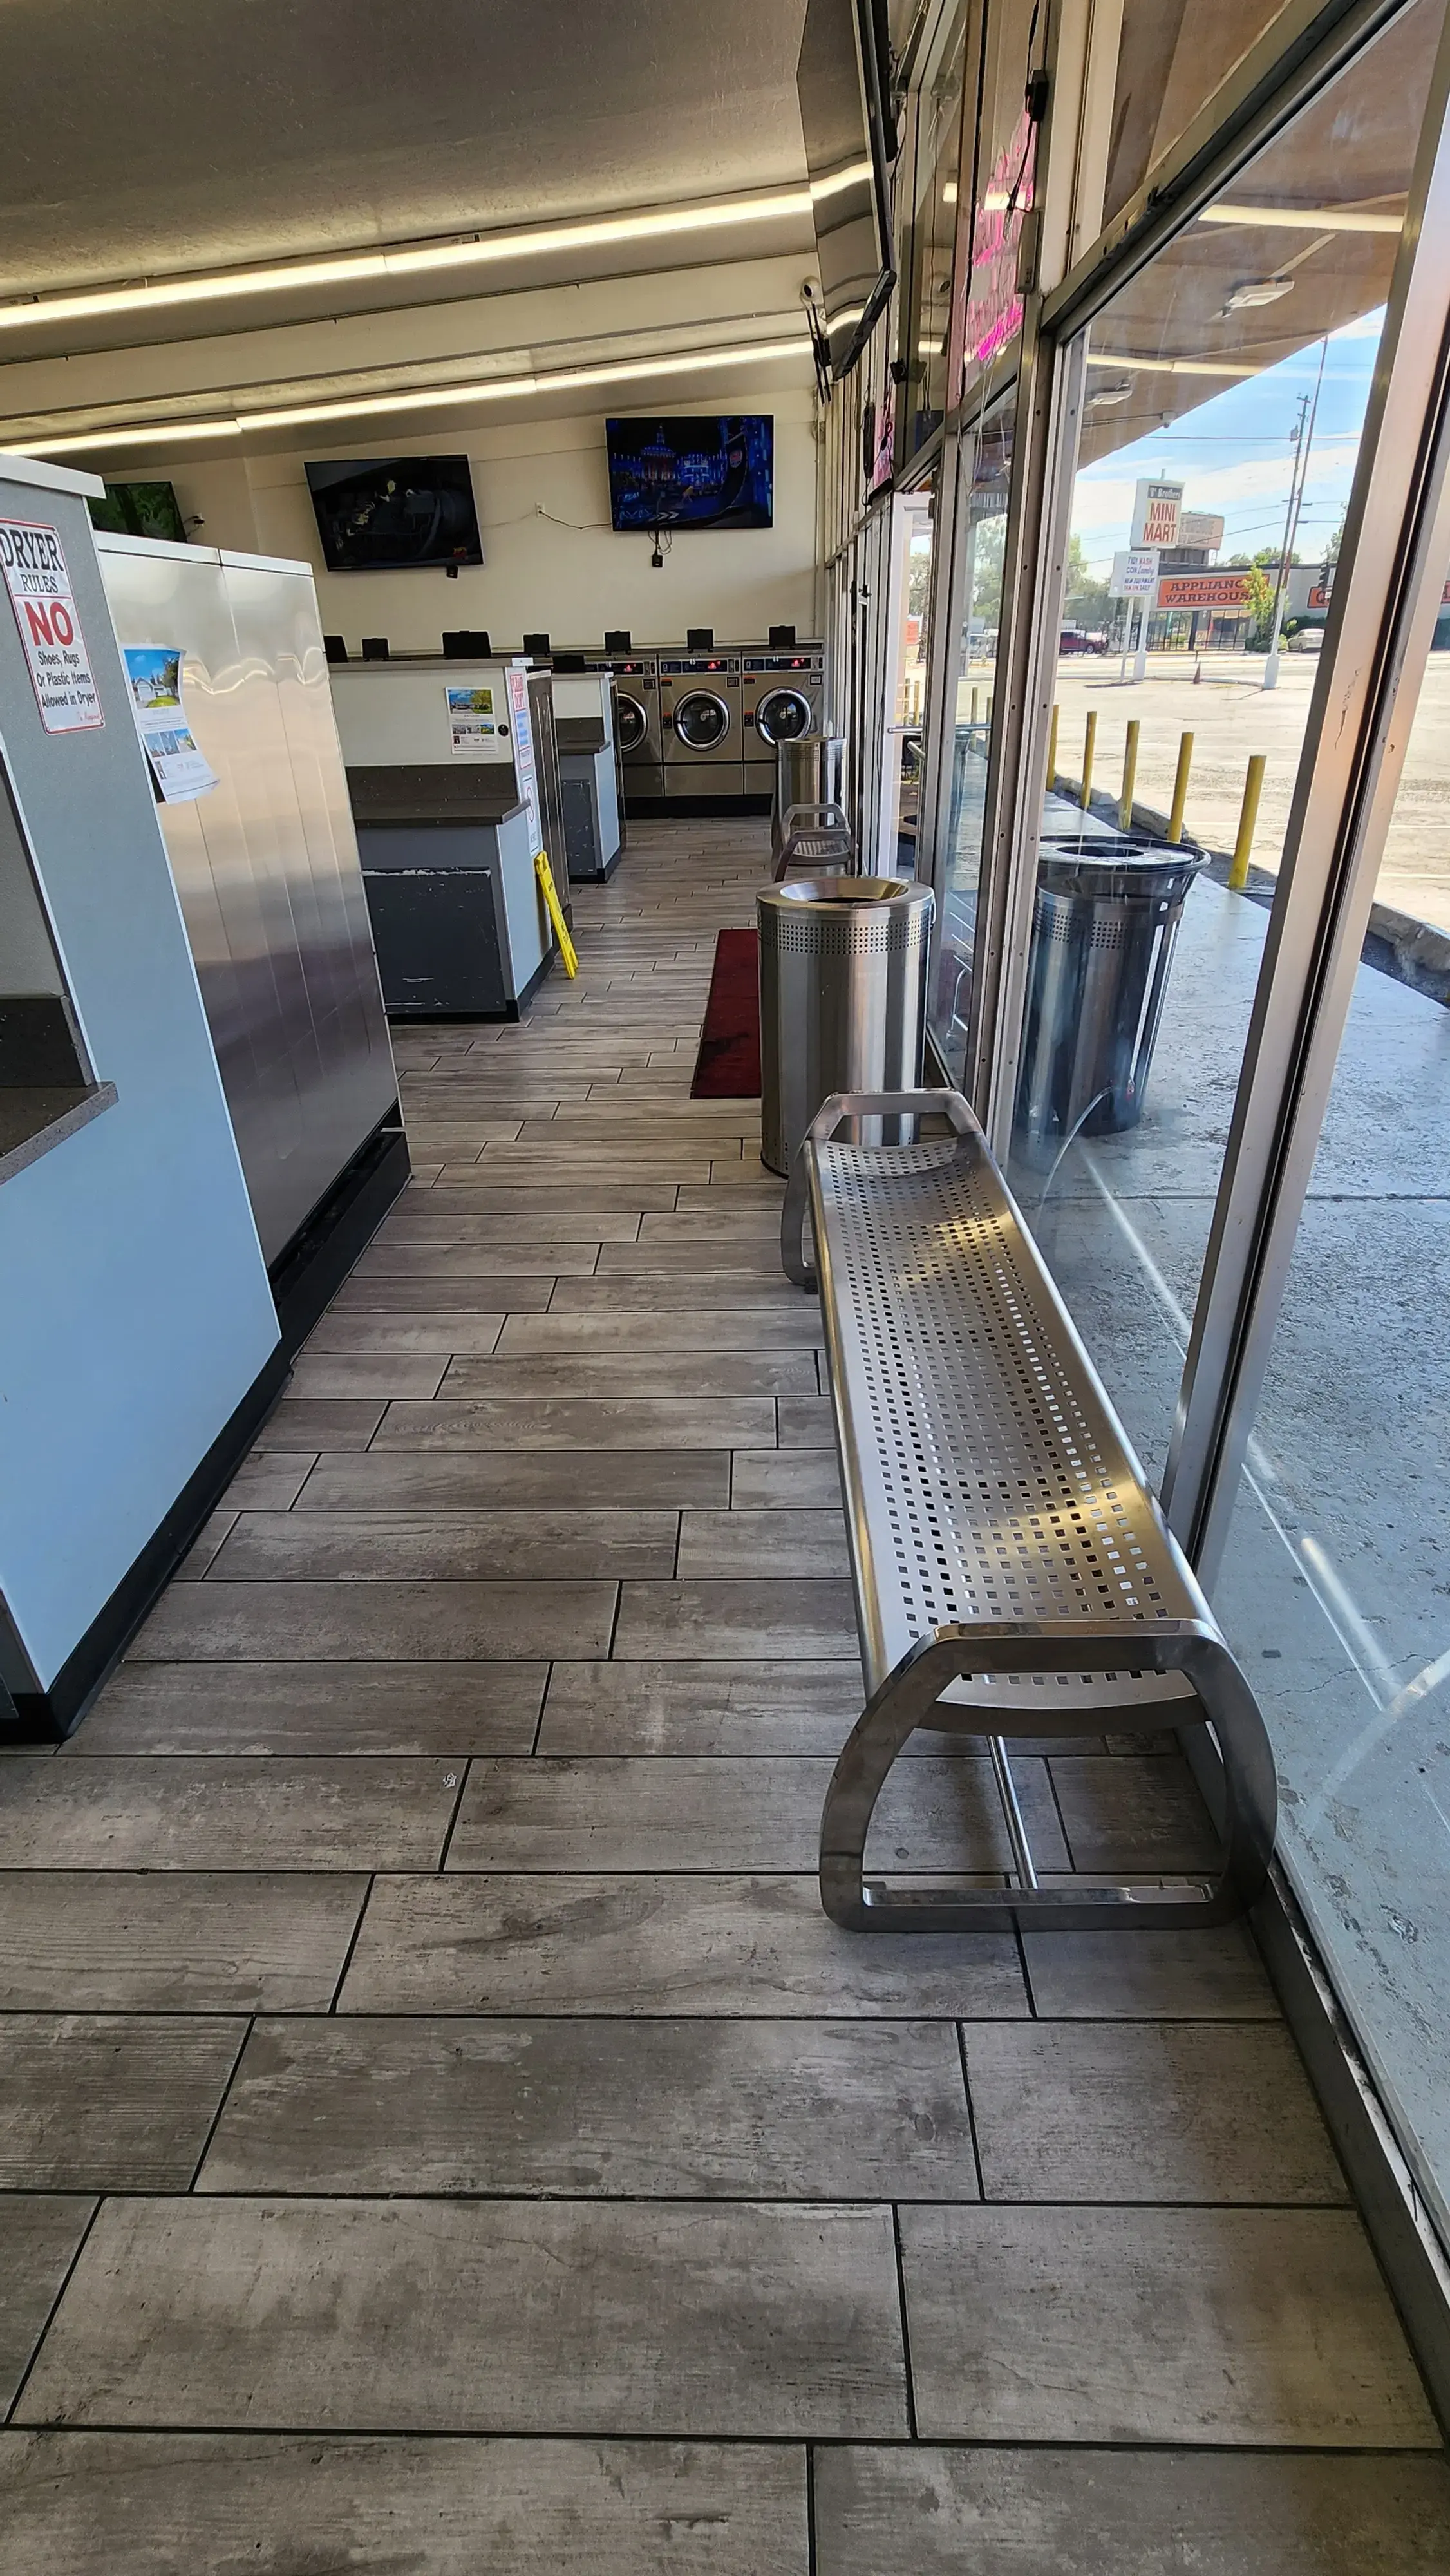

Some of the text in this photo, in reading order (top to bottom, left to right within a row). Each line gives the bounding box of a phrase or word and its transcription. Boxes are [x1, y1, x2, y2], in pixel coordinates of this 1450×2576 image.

[1150, 502, 1176, 522] MINI
[1143, 523, 1177, 542] MART
[0, 528, 64, 572] DRYER
[20, 574, 59, 594] RULES
[1171, 579, 1245, 591] APPLIANC
[24, 601, 74, 646] NO
[37, 650, 80, 667] Shoes, Rugs
[36, 670, 91, 688] Or Plastic Items
[41, 690, 96, 708] Allowed in Dryer
